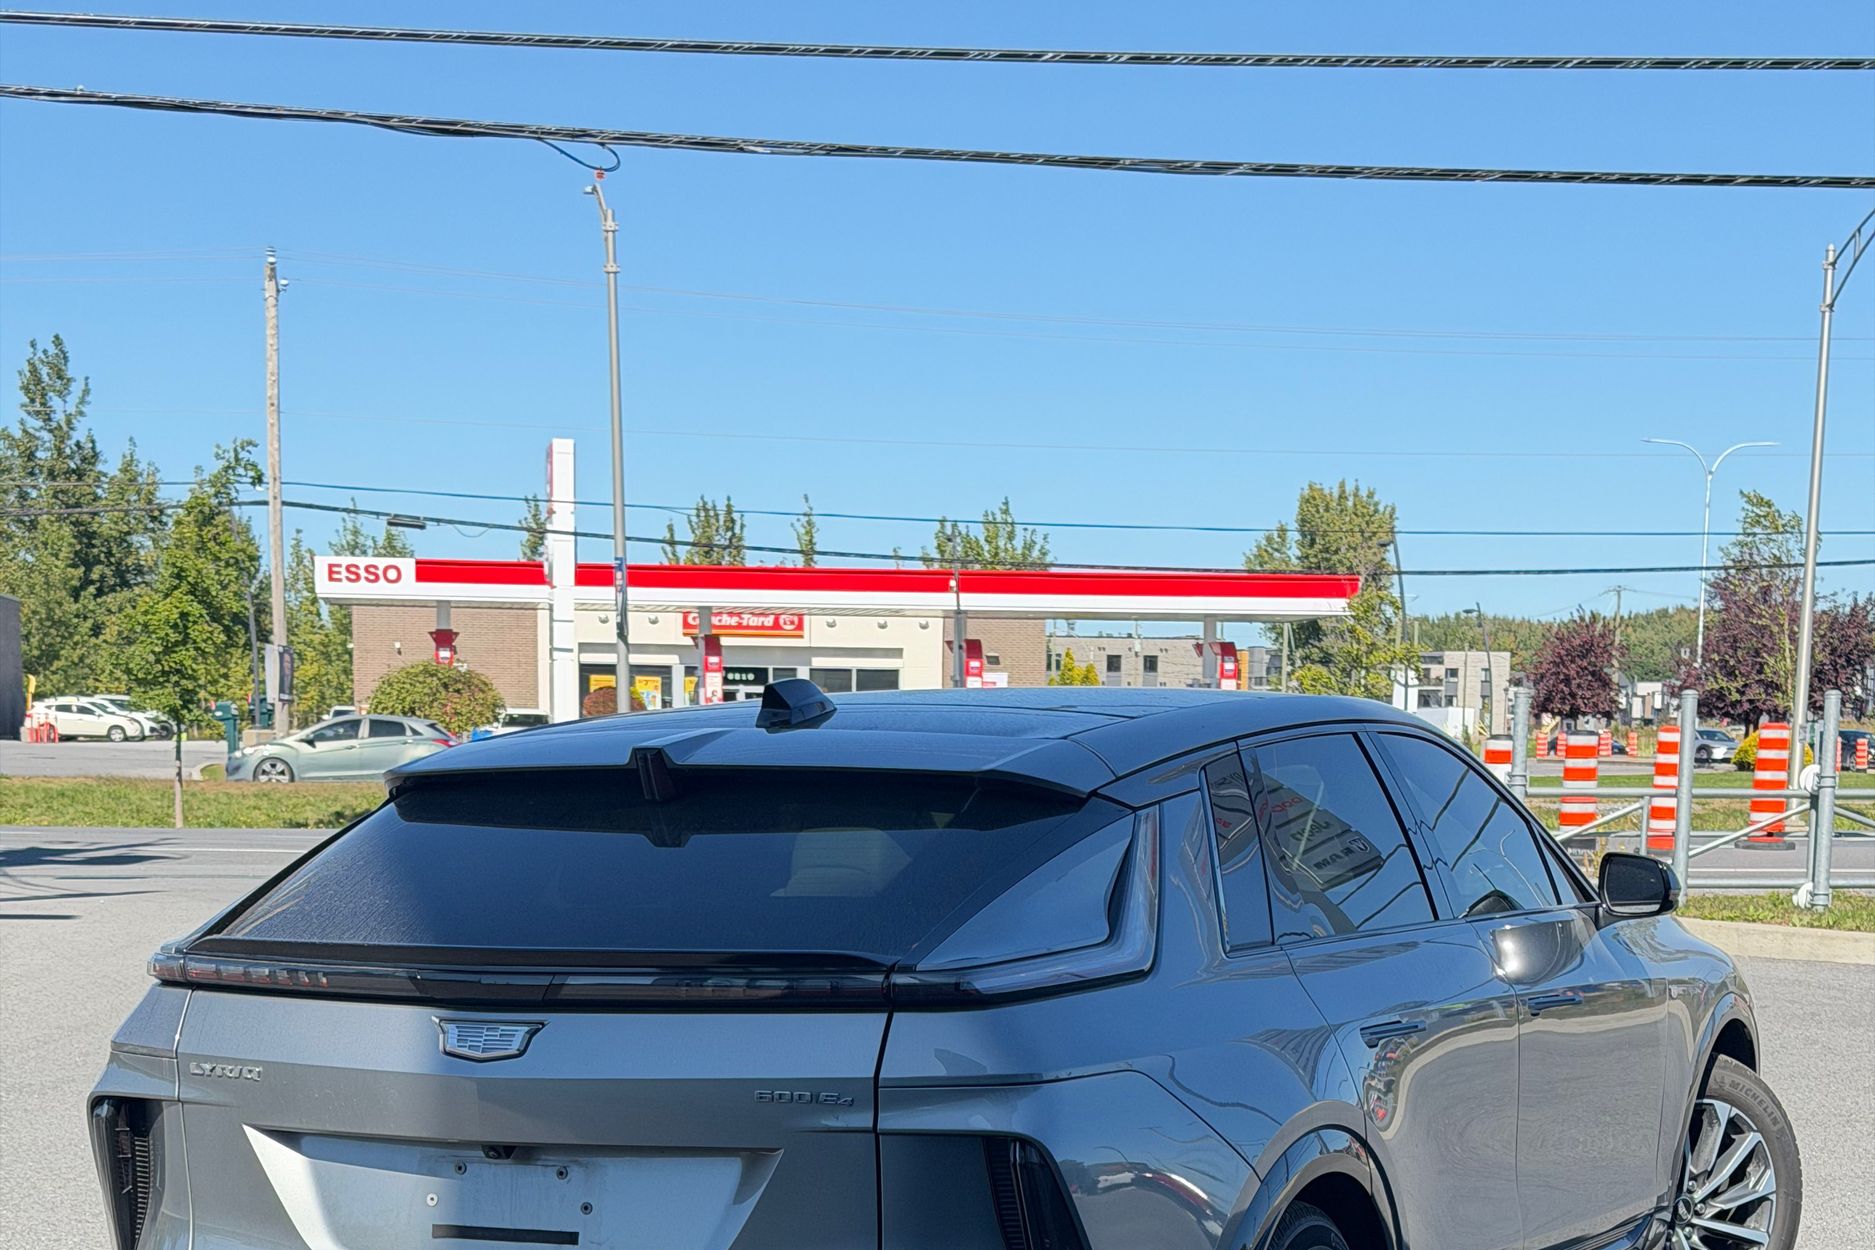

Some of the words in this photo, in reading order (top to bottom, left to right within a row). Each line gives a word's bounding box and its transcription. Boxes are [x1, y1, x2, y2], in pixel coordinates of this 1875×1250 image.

[327, 563, 403, 584] ESSO
[687, 612, 775, 627] Cche-Tard
[754, 1089, 812, 1104] 600
[1728, 1079, 1780, 1127] MICHELIN
